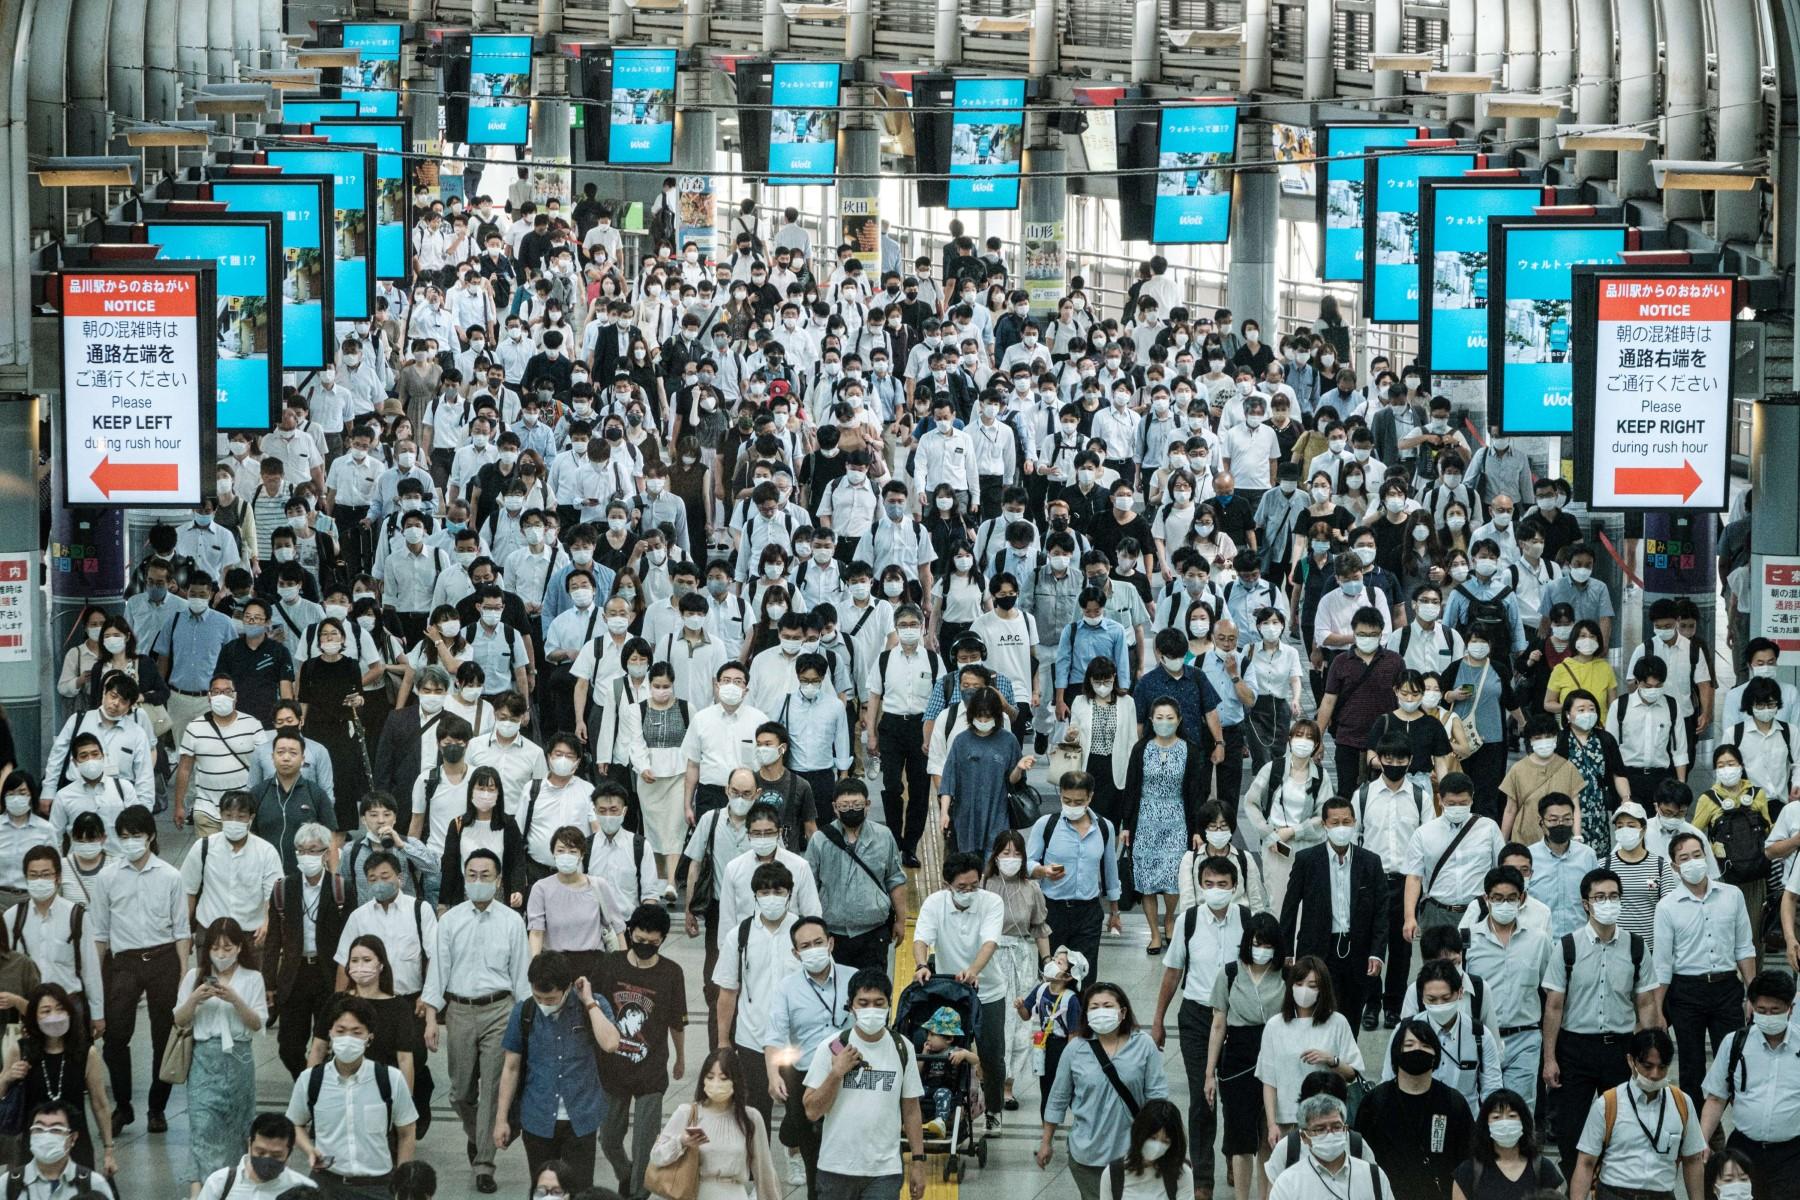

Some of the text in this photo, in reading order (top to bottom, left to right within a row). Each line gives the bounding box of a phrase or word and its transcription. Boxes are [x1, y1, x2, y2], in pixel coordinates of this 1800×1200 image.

[488, 121, 507, 130] Wolt
[630, 140, 651, 149] Wolt
[791, 159, 812, 169] Wolt
[972, 182, 994, 193] Wolt
[844, 200, 868, 214] 秋田
[1179, 215, 1204, 225] Wolt
[1027, 224, 1054, 239] 山形
[69, 279, 189, 294] 品川駅からのおねがい
[1605, 283, 1726, 298] 品川駅からのおねがい
[104, 300, 156, 312] NOTICE
[233, 297, 239, 305] P
[1639, 304, 1691, 317] NOTICE
[82, 320, 179, 339] 朝の混雑時は
[1616, 324, 1712, 343] 朝の混雑時は
[87, 344, 175, 364] 通路左端を
[1618, 348, 1707, 369] 通路右端を
[76, 369, 188, 388] ご通行ください
[1607, 374, 1718, 392] ご通行ください
[112, 395, 152, 409] Please
[1641, 400, 1682, 413] Please
[92, 415, 173, 430] KEEP LEFT
[1616, 419, 1706, 434] KEEP RIGHT
[84, 436, 182, 452] duing rush hour
[1611, 441, 1709, 456] during rush hour
